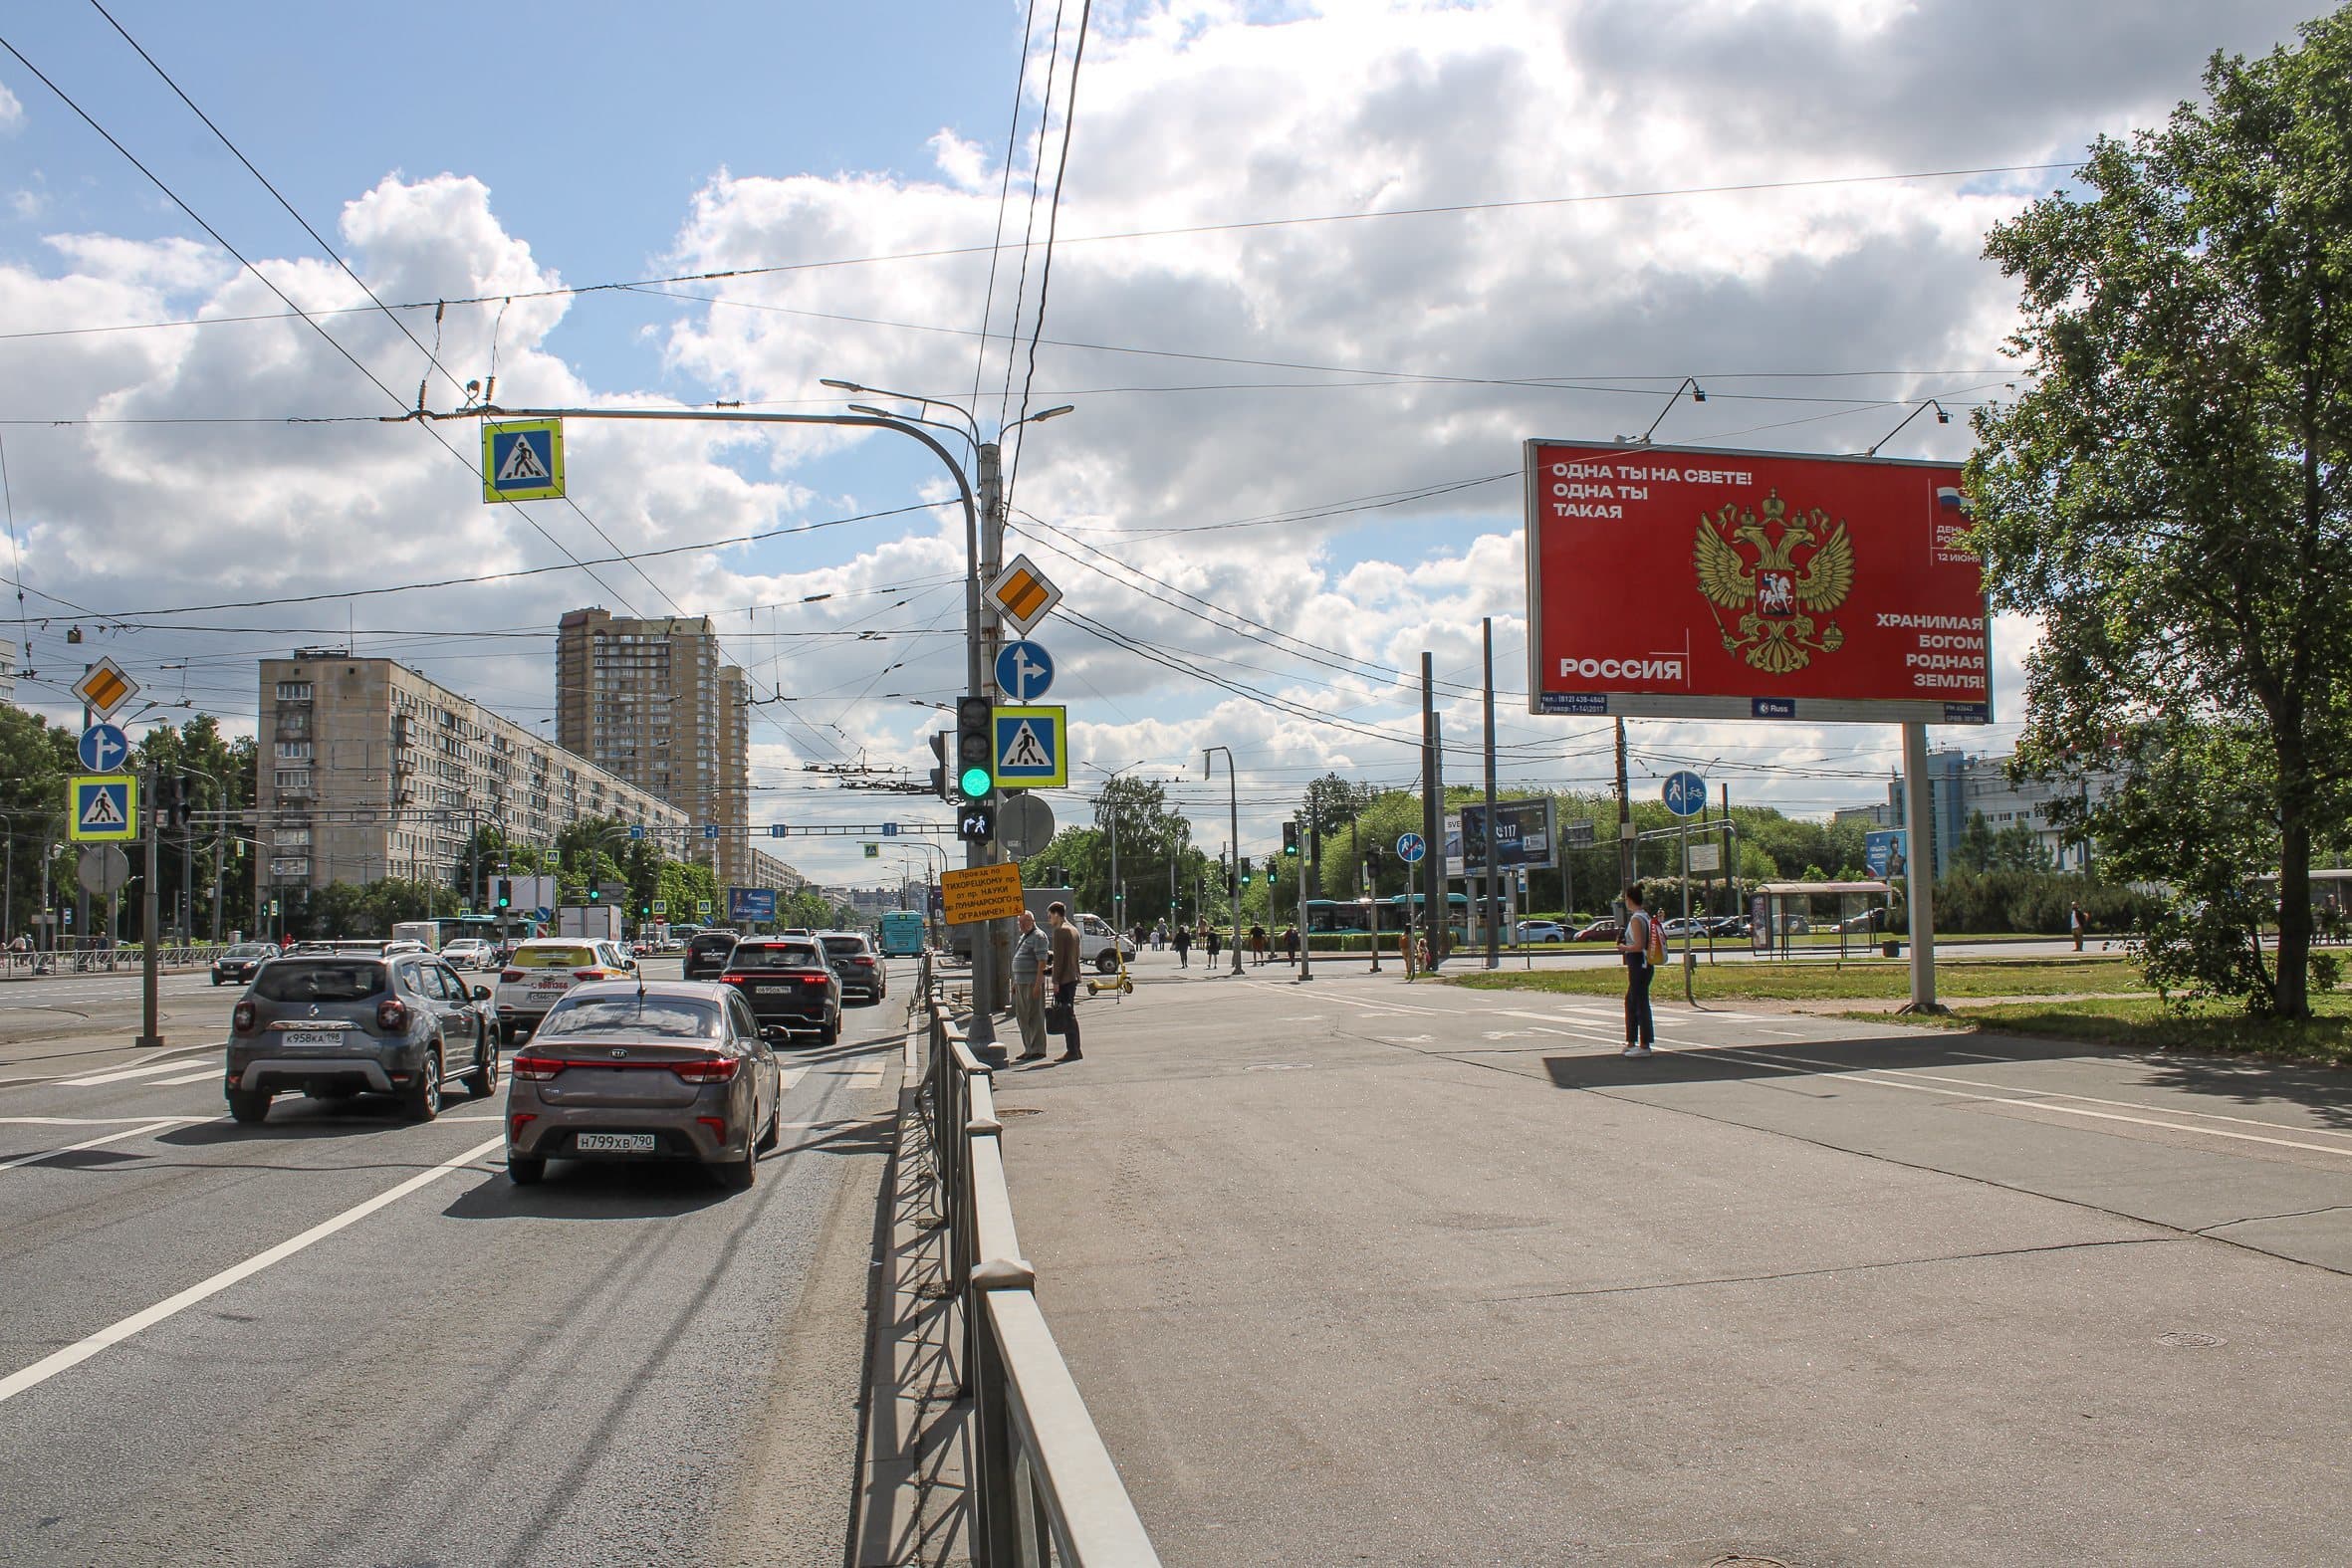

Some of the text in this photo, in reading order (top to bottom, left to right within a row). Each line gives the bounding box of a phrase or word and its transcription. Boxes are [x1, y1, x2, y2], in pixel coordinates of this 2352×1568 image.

[1552, 463, 1753, 486] ОДНА ТЫ НА СВЕТЕ!
[1552, 483, 1648, 500] ОДНА ТЫ
[1553, 503, 1623, 519] ТАКАЯ
[1950, 554, 1982, 563] ИЮНЯ
[1876, 613, 1984, 630] ХРАНИМАЯ
[1919, 634, 1985, 649] БОГОМ
[1560, 658, 1682, 680] РОССИЯ
[1906, 653, 1985, 669] РОДНАЯ
[1913, 673, 1985, 689] ЗЕМЛЯ!
[1769, 704, 1788, 713] Russ
[946, 876, 1003, 891] ТИХОРЕЦКОМУ
[981, 886, 1009, 895] НАУКИ
[958, 907, 1005, 920] ОГРАНИЧЕН
